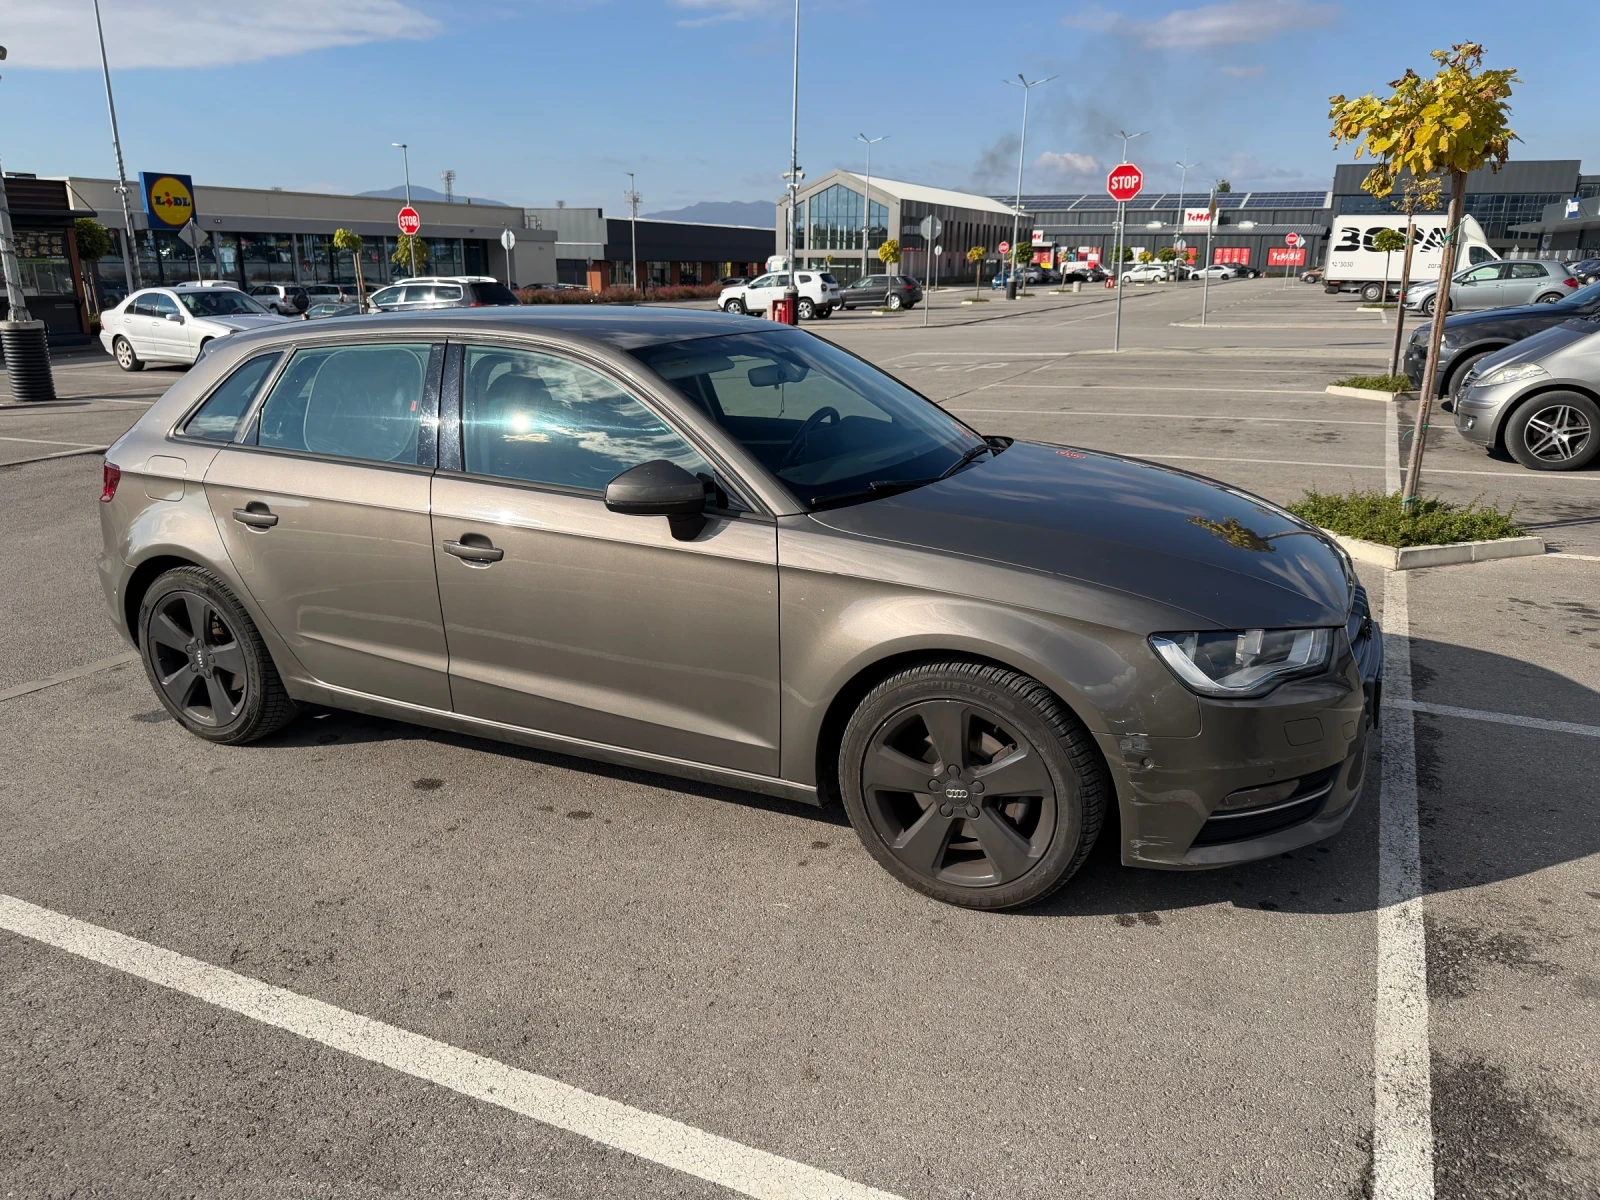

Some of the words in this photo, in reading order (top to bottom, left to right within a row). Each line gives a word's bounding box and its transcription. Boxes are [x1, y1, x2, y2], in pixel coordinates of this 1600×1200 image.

[1111, 175, 1139, 190] STOP
[400, 215, 418, 227] STOP
[1187, 212, 1216, 222] TeMA
